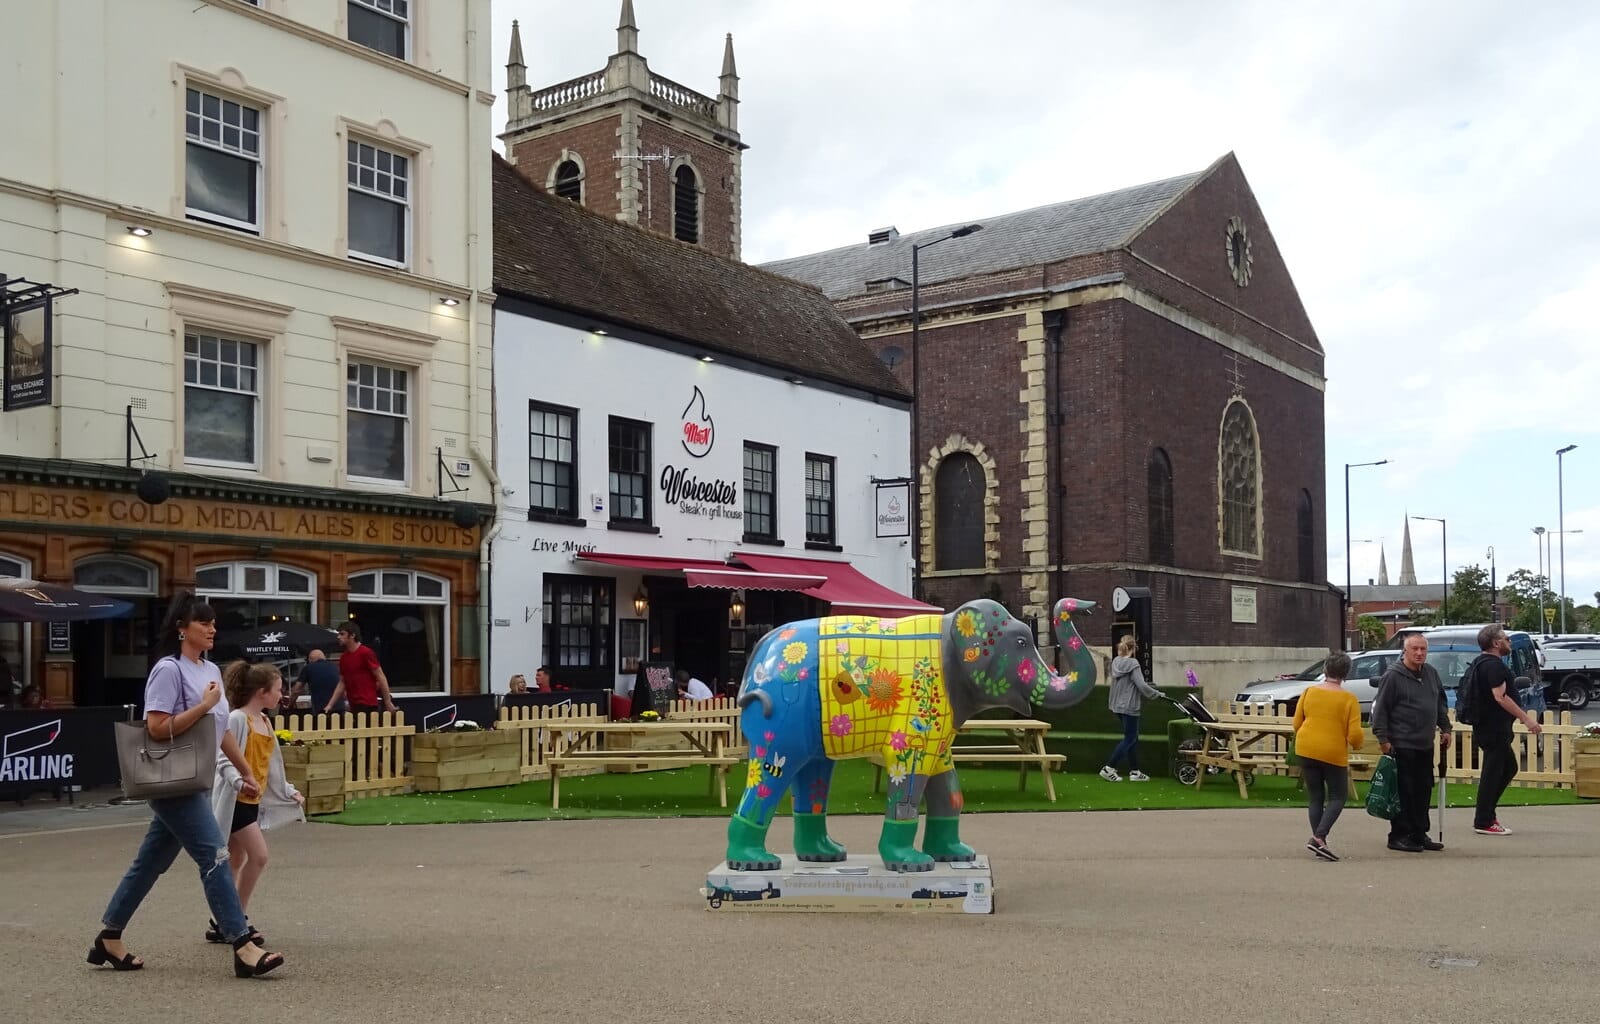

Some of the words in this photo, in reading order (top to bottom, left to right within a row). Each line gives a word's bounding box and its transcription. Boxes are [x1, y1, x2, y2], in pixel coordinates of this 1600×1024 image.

[661, 464, 737, 505] Worcester
[108, 500, 184, 525] GOLD
[197, 505, 284, 533] MEDAL
[294, 512, 354, 538] ALES
[366, 519, 379, 538] &
[392, 521, 474, 546] STOUTS
[709, 504, 721, 520] grill
[723, 506, 743, 519] house
[531, 537, 558, 552] Live
[561, 540, 597, 553] Music
[0, 753, 74, 782] ARLING
